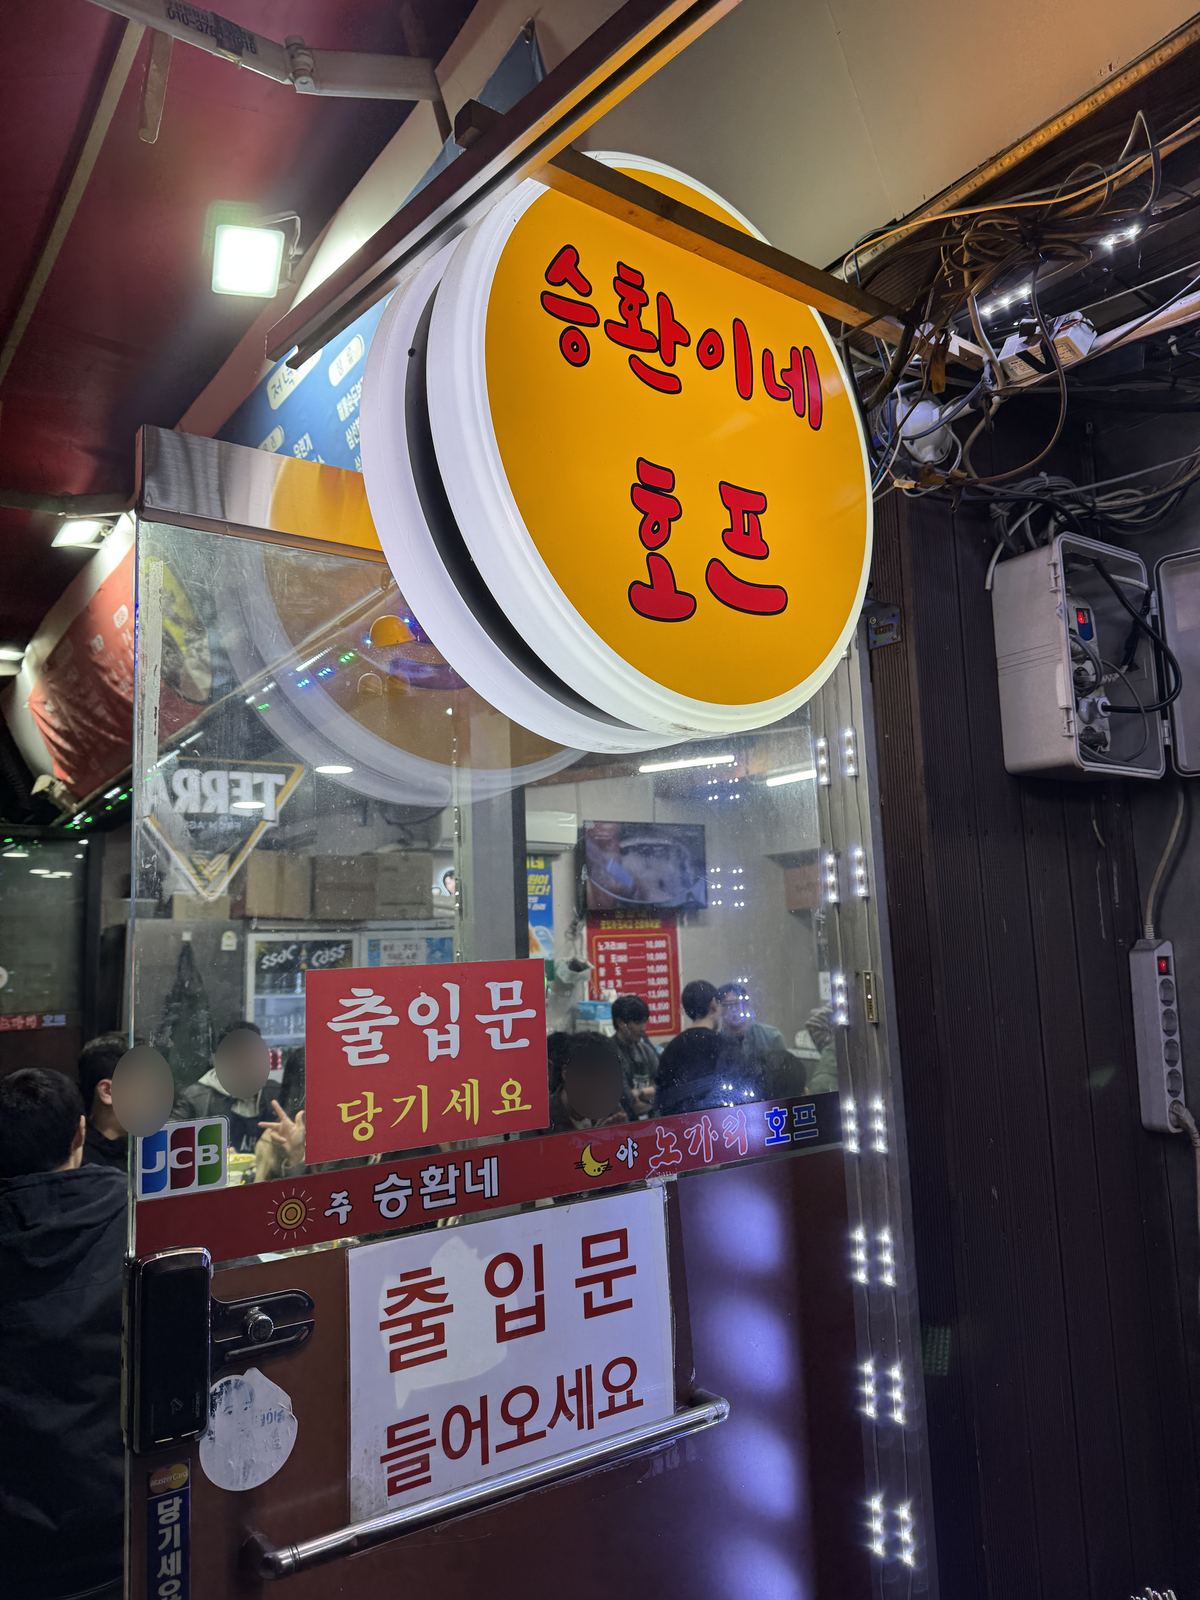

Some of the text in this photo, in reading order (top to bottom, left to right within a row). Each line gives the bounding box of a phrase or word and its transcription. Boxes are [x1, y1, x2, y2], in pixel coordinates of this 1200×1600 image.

[540, 243, 823, 431] 승환이네
[627, 457, 789, 622] 호프
[327, 980, 537, 1067] 출입문
[141, 1143, 220, 1174] JCB
[324, 1103, 819, 1225] 주 승환네 야 노가리 호프
[337, 1078, 532, 1142] 당기세요
[379, 1227, 637, 1374] 출입문
[379, 1356, 645, 1497] 들어오세요
